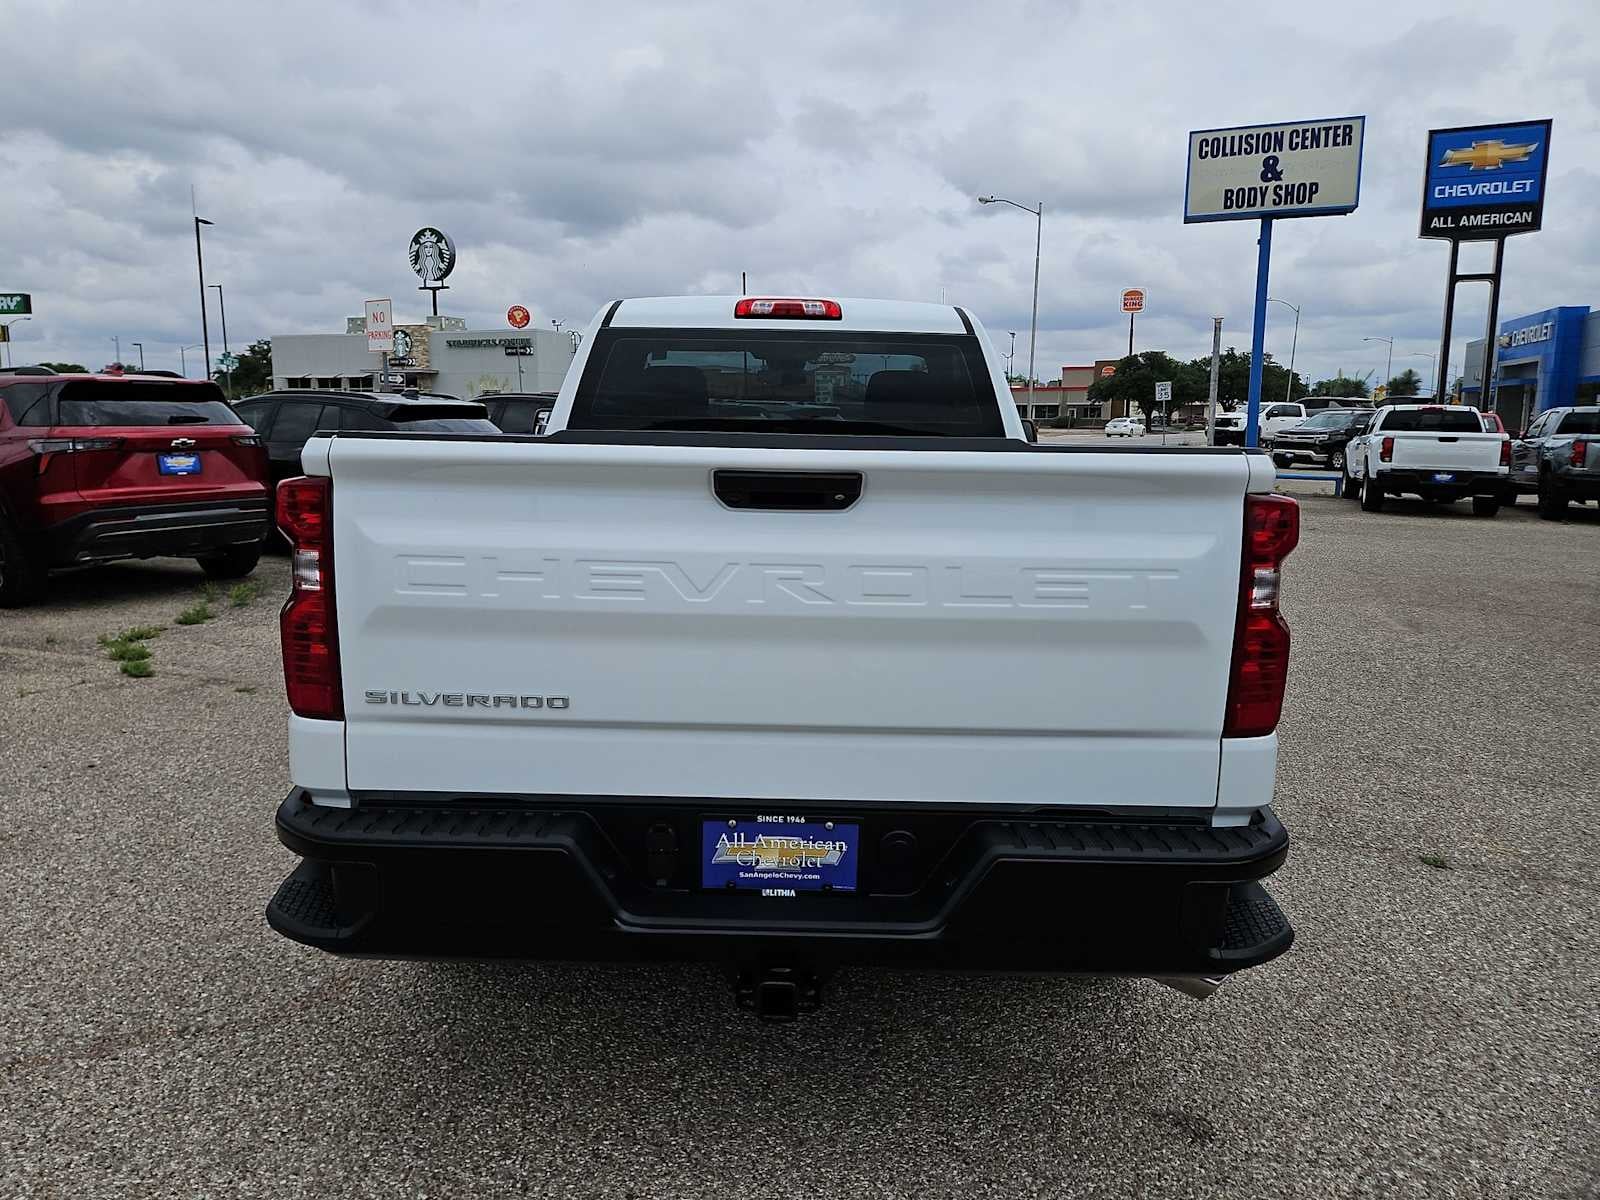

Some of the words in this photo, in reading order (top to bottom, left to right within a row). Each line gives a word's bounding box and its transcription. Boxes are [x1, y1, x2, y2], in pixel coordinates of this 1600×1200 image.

[1199, 130, 1285, 160] COLLISION
[1288, 124, 1353, 152] CENTER
[1260, 155, 1283, 183] &
[1223, 185, 1269, 210] BODY
[1272, 181, 1319, 206] SHOP
[1434, 179, 1535, 198] CHEVROLET
[1430, 216, 1455, 229] ALL
[1459, 211, 1533, 227] AMERICAN
[1123, 300, 1144, 308] KING
[372, 311, 385, 323] NO
[367, 329, 392, 341] PARKING
[1511, 322, 1552, 347] CHEVROLET
[394, 554, 1180, 609] CHEVROLET
[365, 690, 570, 709] SILVERADO
[757, 815, 785, 824] SINCE
[786, 815, 806, 824] 1946
[715, 832, 745, 849] All
[753, 833, 848, 852] American
[736, 850, 823, 869] Chevrolet
[739, 871, 820, 880] SanAngeloChevy.com
[769, 888, 796, 897] LITHIA
